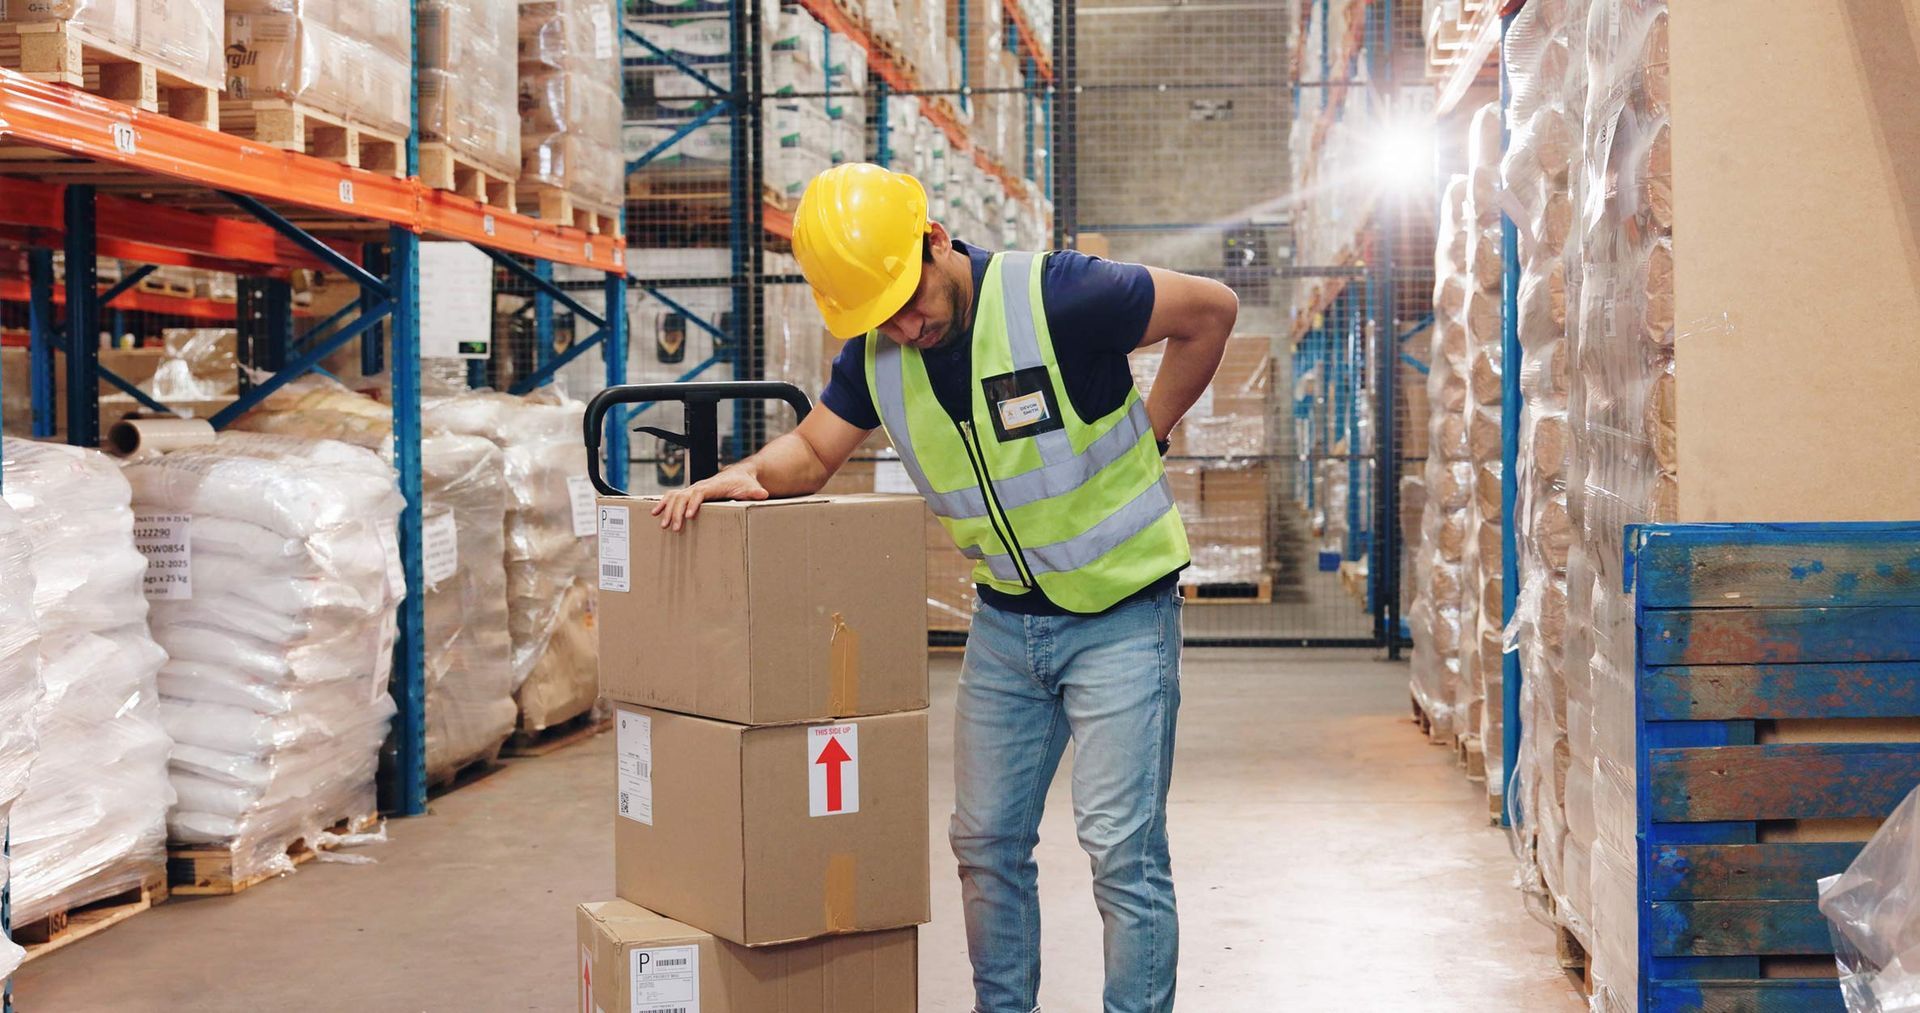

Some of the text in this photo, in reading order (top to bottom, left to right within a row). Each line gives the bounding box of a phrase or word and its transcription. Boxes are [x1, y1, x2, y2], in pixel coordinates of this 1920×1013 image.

[225, 51, 258, 69] rgill
[120, 128, 131, 150] 17
[602, 510, 608, 529] P
[148, 560, 188, 568] 1-12-2025
[144, 576, 157, 584] ags
[166, 574, 176, 582] 25
[177, 574, 188, 584] kg
[829, 727, 841, 735] SIDE
[842, 726, 851, 734] UP
[639, 953, 650, 973] P
